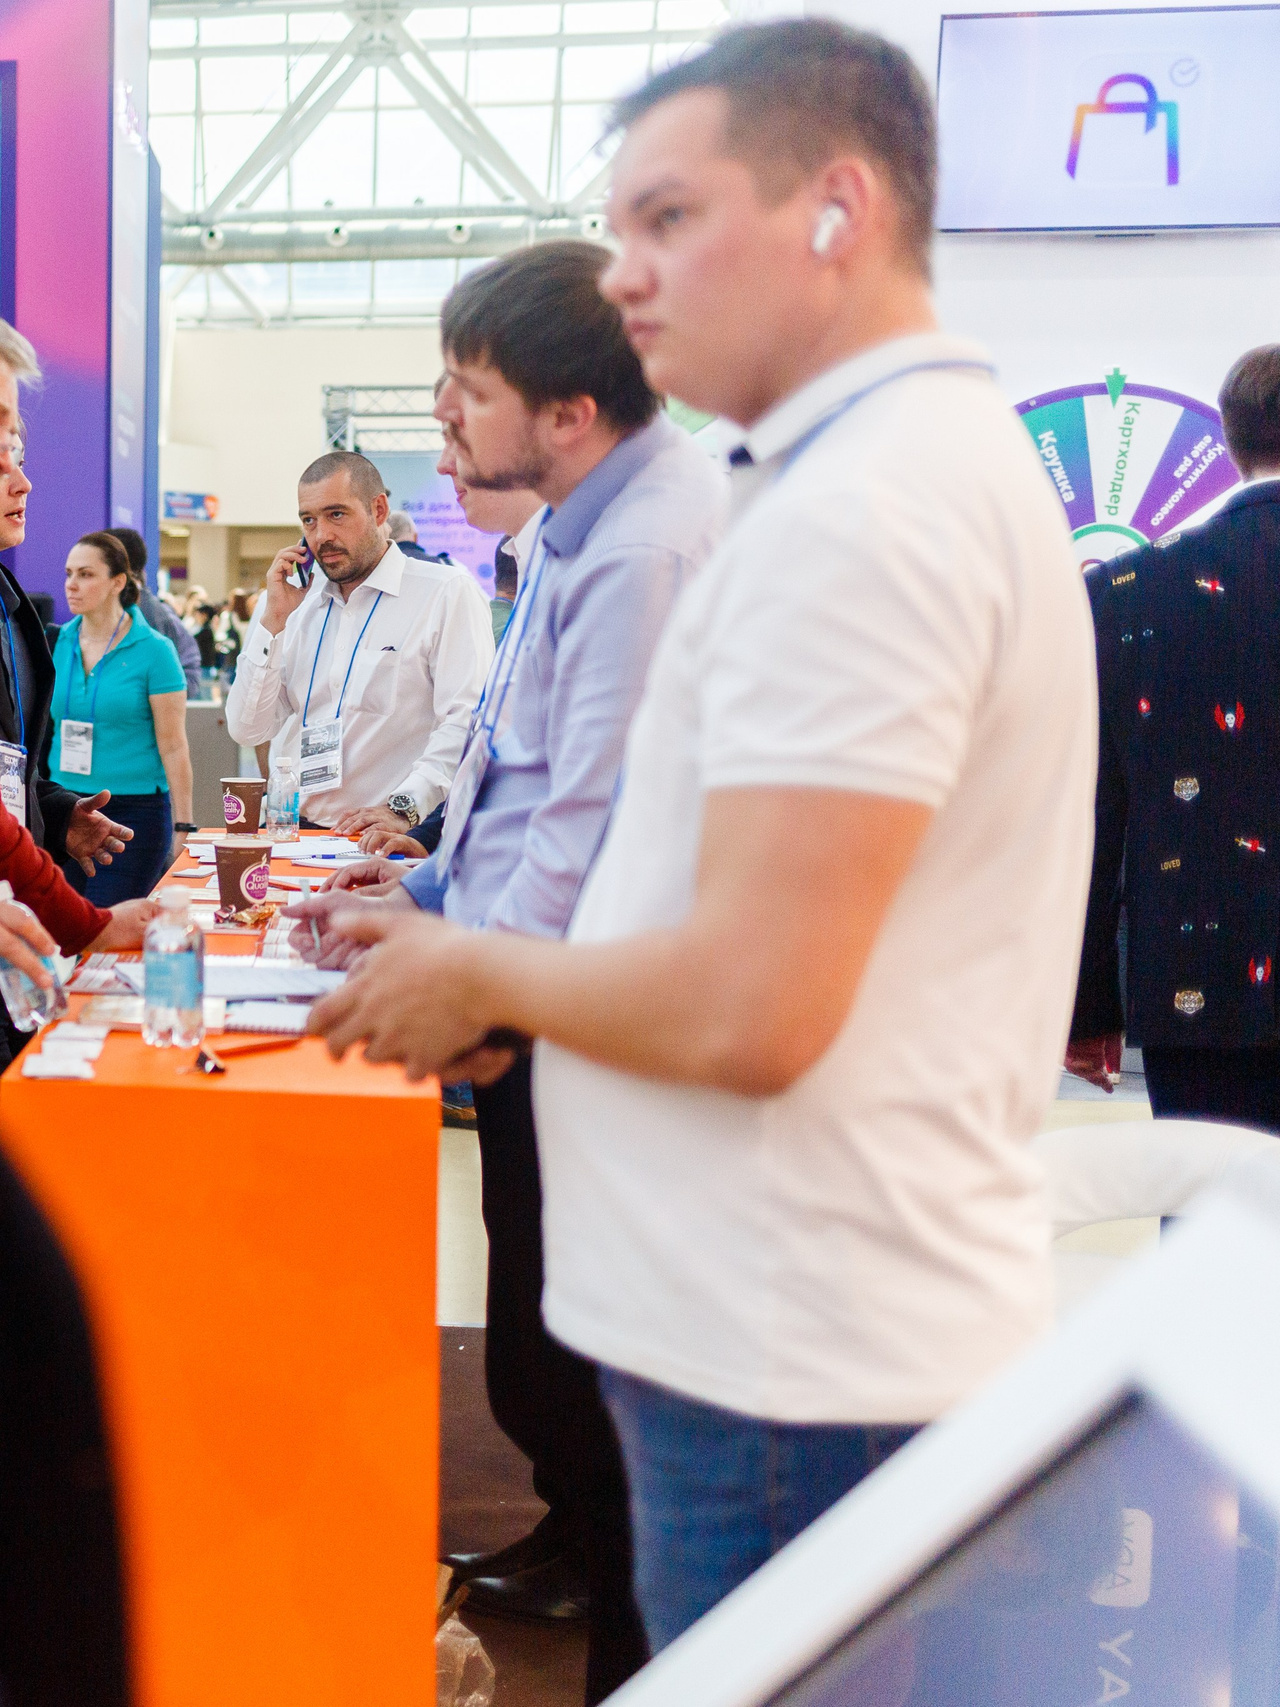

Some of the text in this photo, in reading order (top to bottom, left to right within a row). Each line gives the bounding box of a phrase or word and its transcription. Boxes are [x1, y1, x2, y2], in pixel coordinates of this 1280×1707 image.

[1037, 430, 1076, 504] Кружка
[1104, 401, 1142, 516] Картхолдер
[1173, 456, 1194, 480] раз
[1150, 442, 1226, 527] Крутите колесо
[1112, 572, 1136, 586] LOVED
[1160, 859, 1181, 871] LOVED
